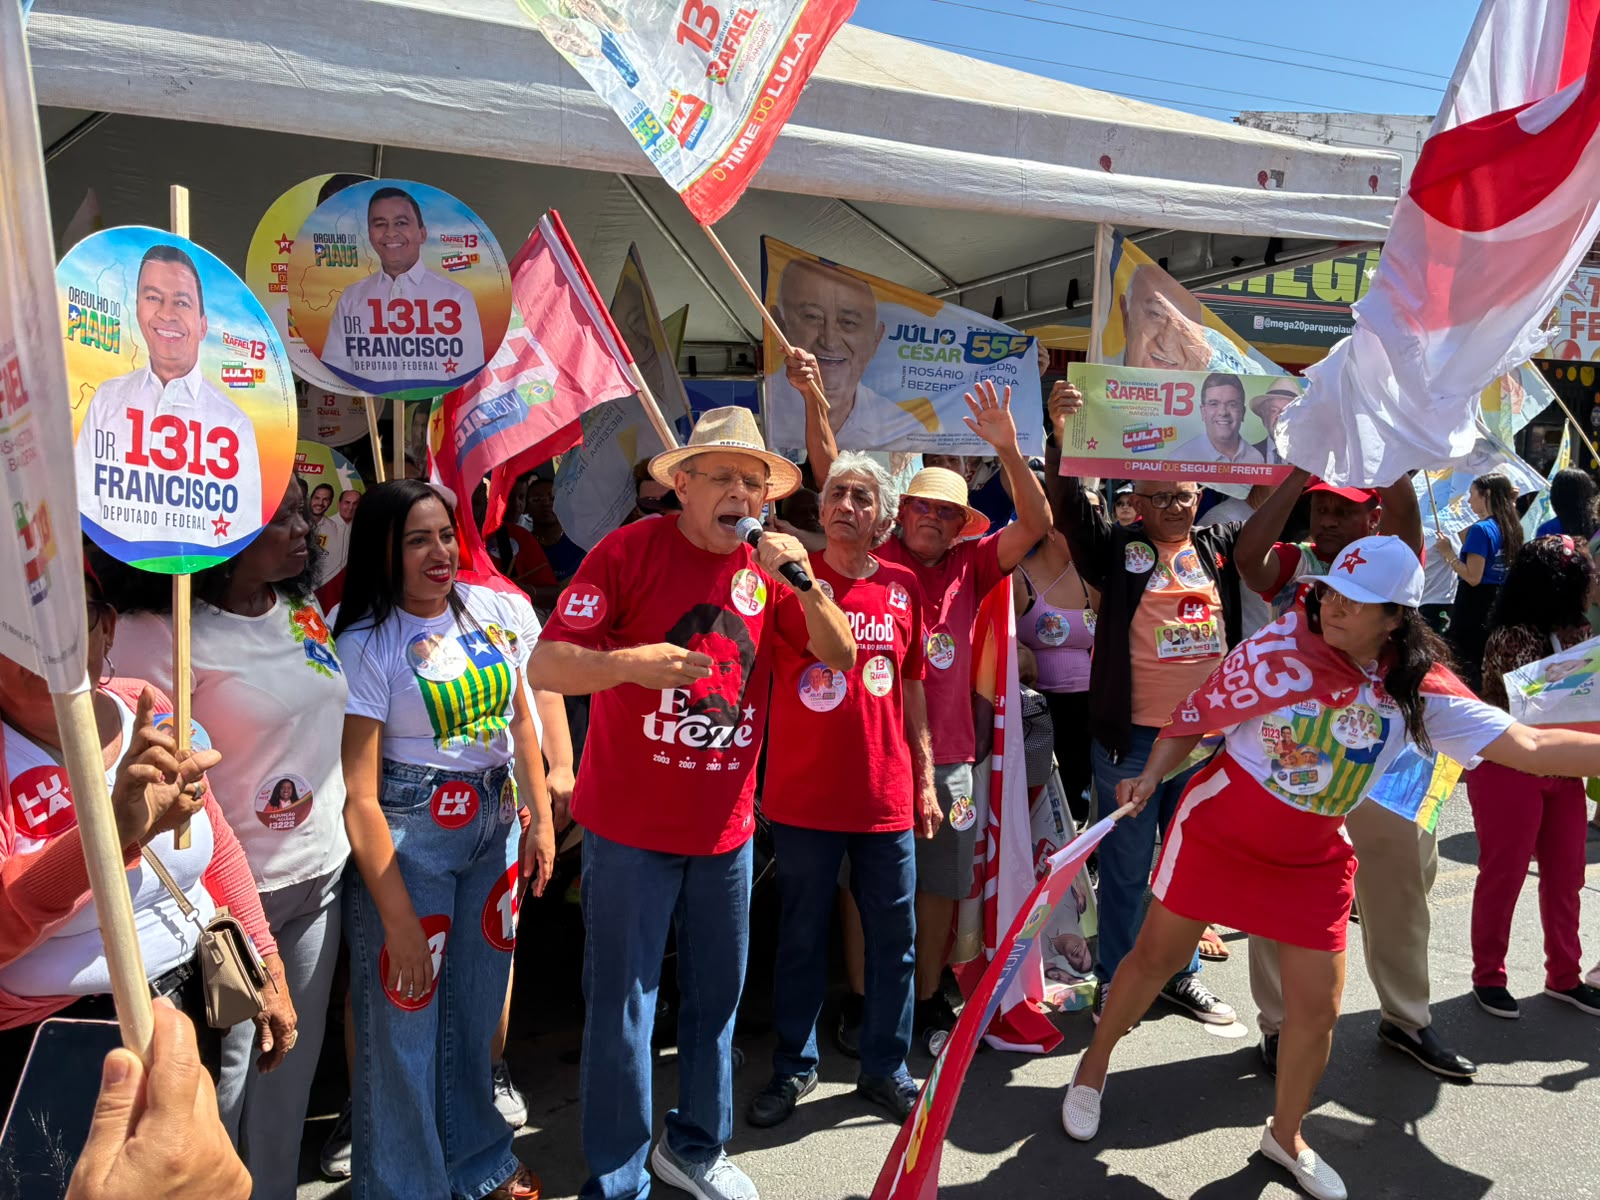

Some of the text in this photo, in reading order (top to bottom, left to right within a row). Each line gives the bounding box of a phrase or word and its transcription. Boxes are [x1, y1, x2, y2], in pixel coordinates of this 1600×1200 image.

[677, 0, 720, 53] 13
[706, 8, 758, 86] RAFAEL
[711, 33, 812, 182] O TIME DO LULA
[313, 233, 357, 244] ORGULHO DO
[440, 234, 478, 248] RAFAEL 13
[314, 244, 359, 268] PIAUÍ
[442, 255, 469, 266] LULA
[68, 286, 121, 318] ORGULHO DO
[344, 298, 462, 335] DR. 1313
[67, 303, 121, 354] PIAUÍ
[888, 324, 957, 346] JÚLIO
[222, 332, 251, 350] RAFAEL
[250, 340, 267, 360] 13
[345, 336, 463, 358] FRANCISCO
[897, 343, 962, 364] CÉSAR
[971, 335, 1028, 360] 555
[222, 368, 265, 379] LULA 13
[354, 361, 439, 371] DEPUTADO FEDERAL
[908, 366, 964, 380] ROSÁRIO
[980, 363, 1018, 375] EDRO
[323, 394, 336, 407] 13
[1106, 379, 1195, 417] RAFAEL 13
[317, 407, 341, 417] RAFAEL
[95, 428, 119, 462] DR.
[125, 407, 240, 480] 1313
[1123, 427, 1174, 443] LULA 13
[298, 464, 322, 473] LULA
[1124, 460, 1273, 475] O PIAUÍ QUE SEGUE EM FRENTE
[94, 463, 239, 514] FRANCISCO
[103, 504, 206, 531] DEPUTADO FEDERAL
[748, 598, 759, 611] 13
[874, 659, 886, 671] 13
[659, 688, 691, 717] E
[1181, 705, 1200, 723] 13
[641, 711, 753, 748] treze
[653, 753, 670, 764] 2003
[678, 760, 696, 769] 2007
[269, 821, 295, 829] 13222
